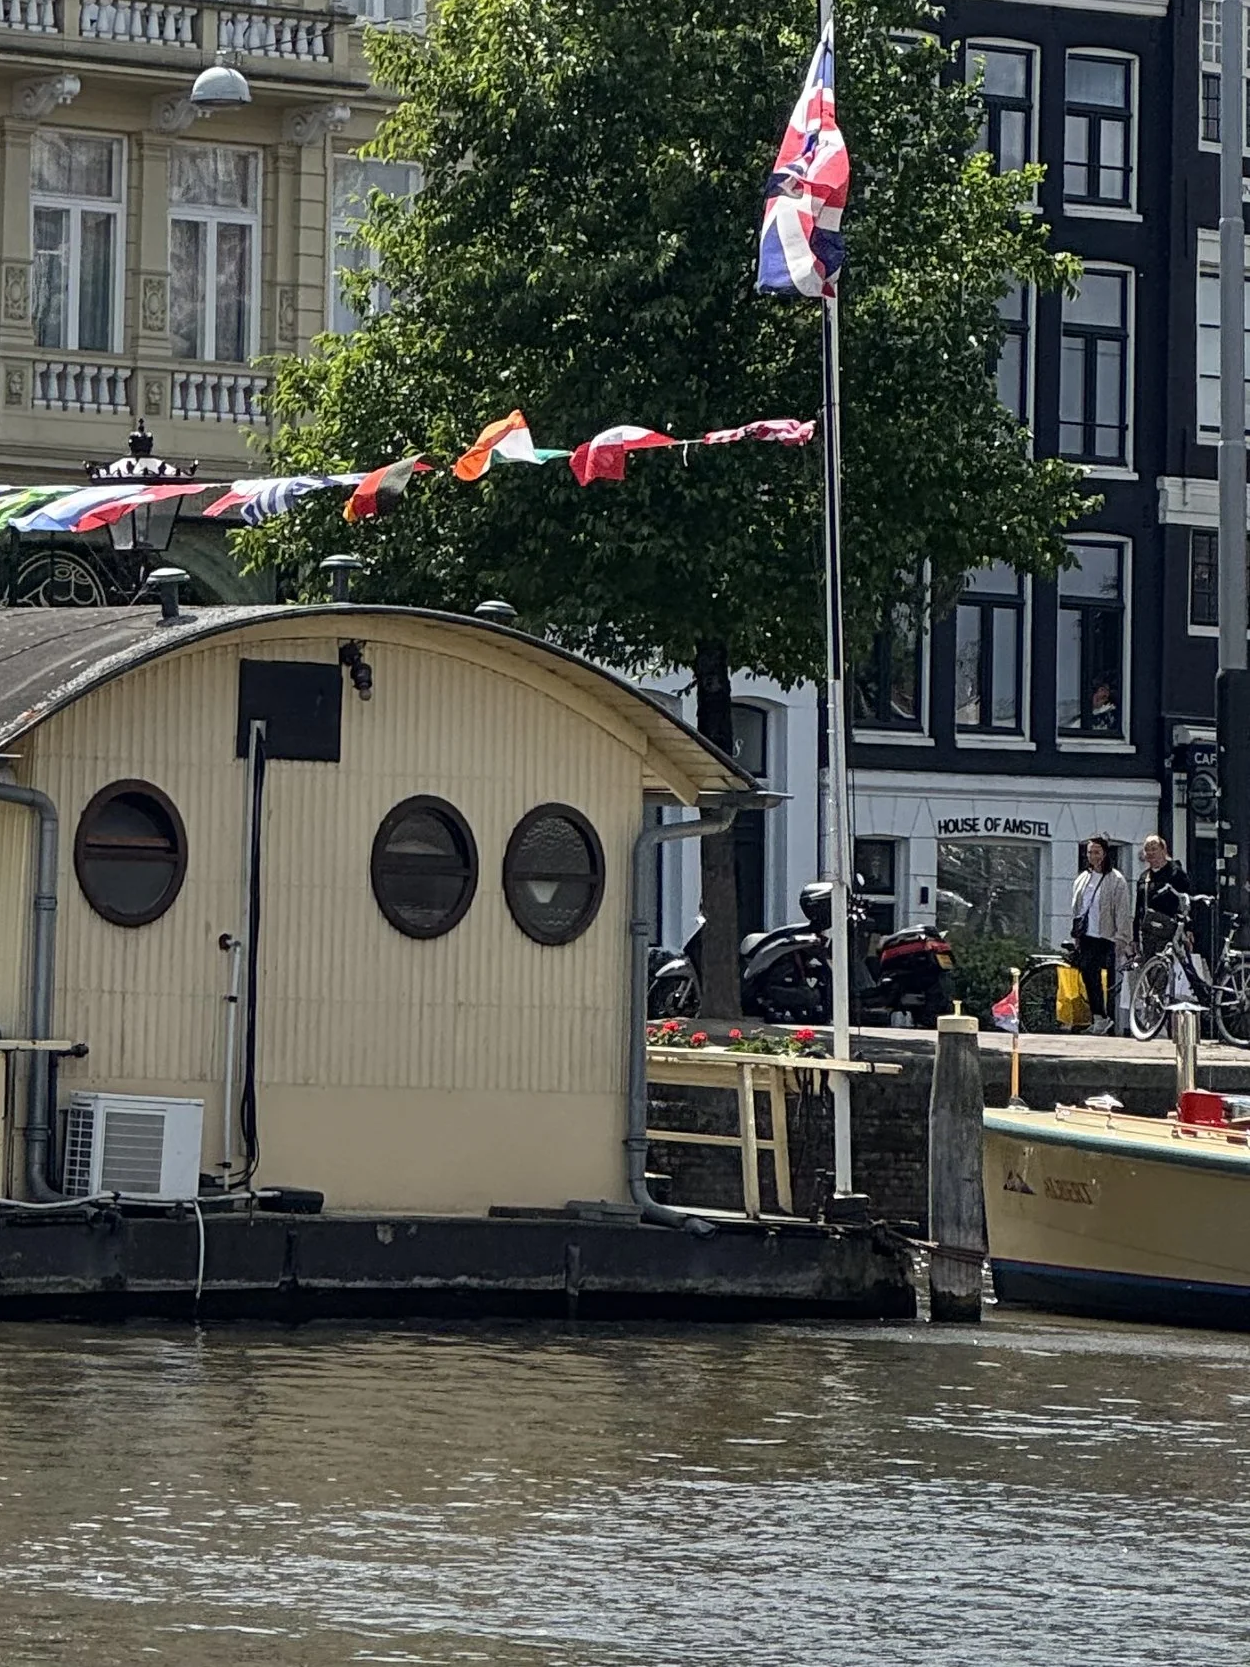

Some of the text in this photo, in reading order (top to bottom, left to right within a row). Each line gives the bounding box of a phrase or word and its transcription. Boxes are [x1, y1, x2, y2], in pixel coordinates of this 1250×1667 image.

[938, 817, 1052, 838] HOUSE OF AMSTEL
